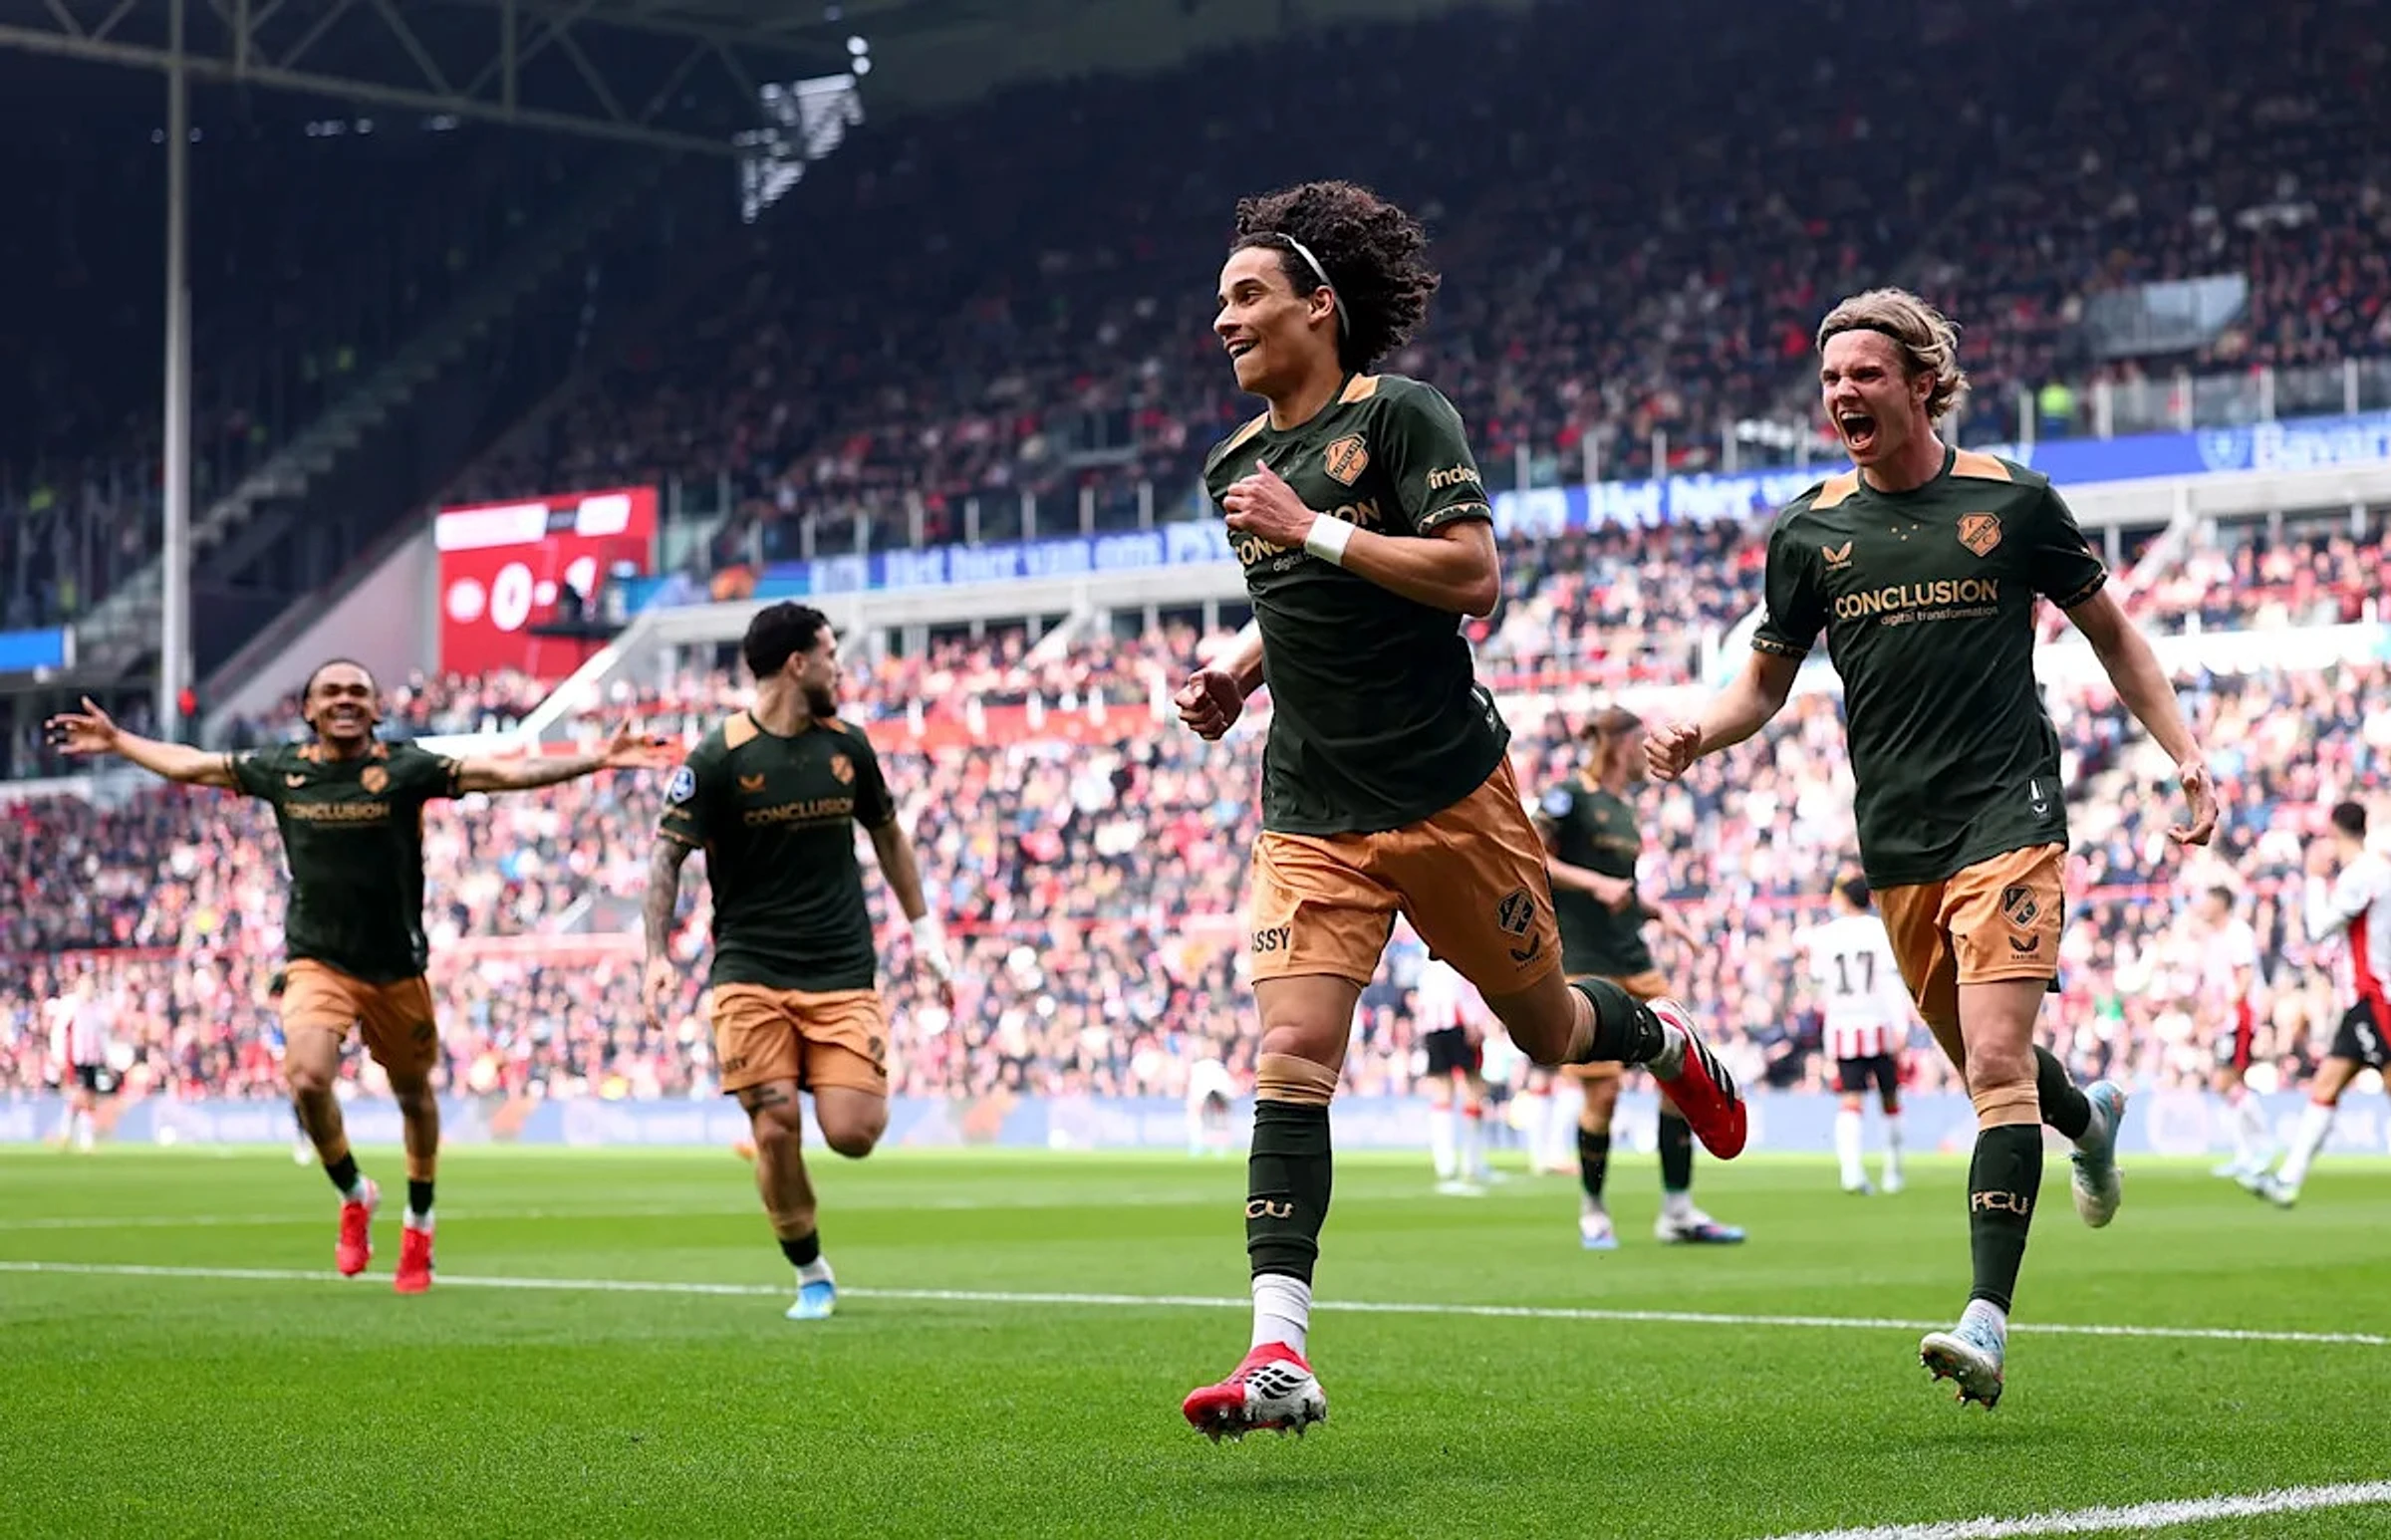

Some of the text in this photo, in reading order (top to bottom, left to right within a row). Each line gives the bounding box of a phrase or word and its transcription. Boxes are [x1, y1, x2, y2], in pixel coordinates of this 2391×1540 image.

[491, 562, 533, 632] 0
[1835, 579, 1997, 619] CONCLUSION
[1881, 606, 1998, 627] digital transformation
[1251, 927, 1290, 952] SSY
[1834, 950, 1875, 995] 17
[1972, 1190, 2028, 1214] FCU
